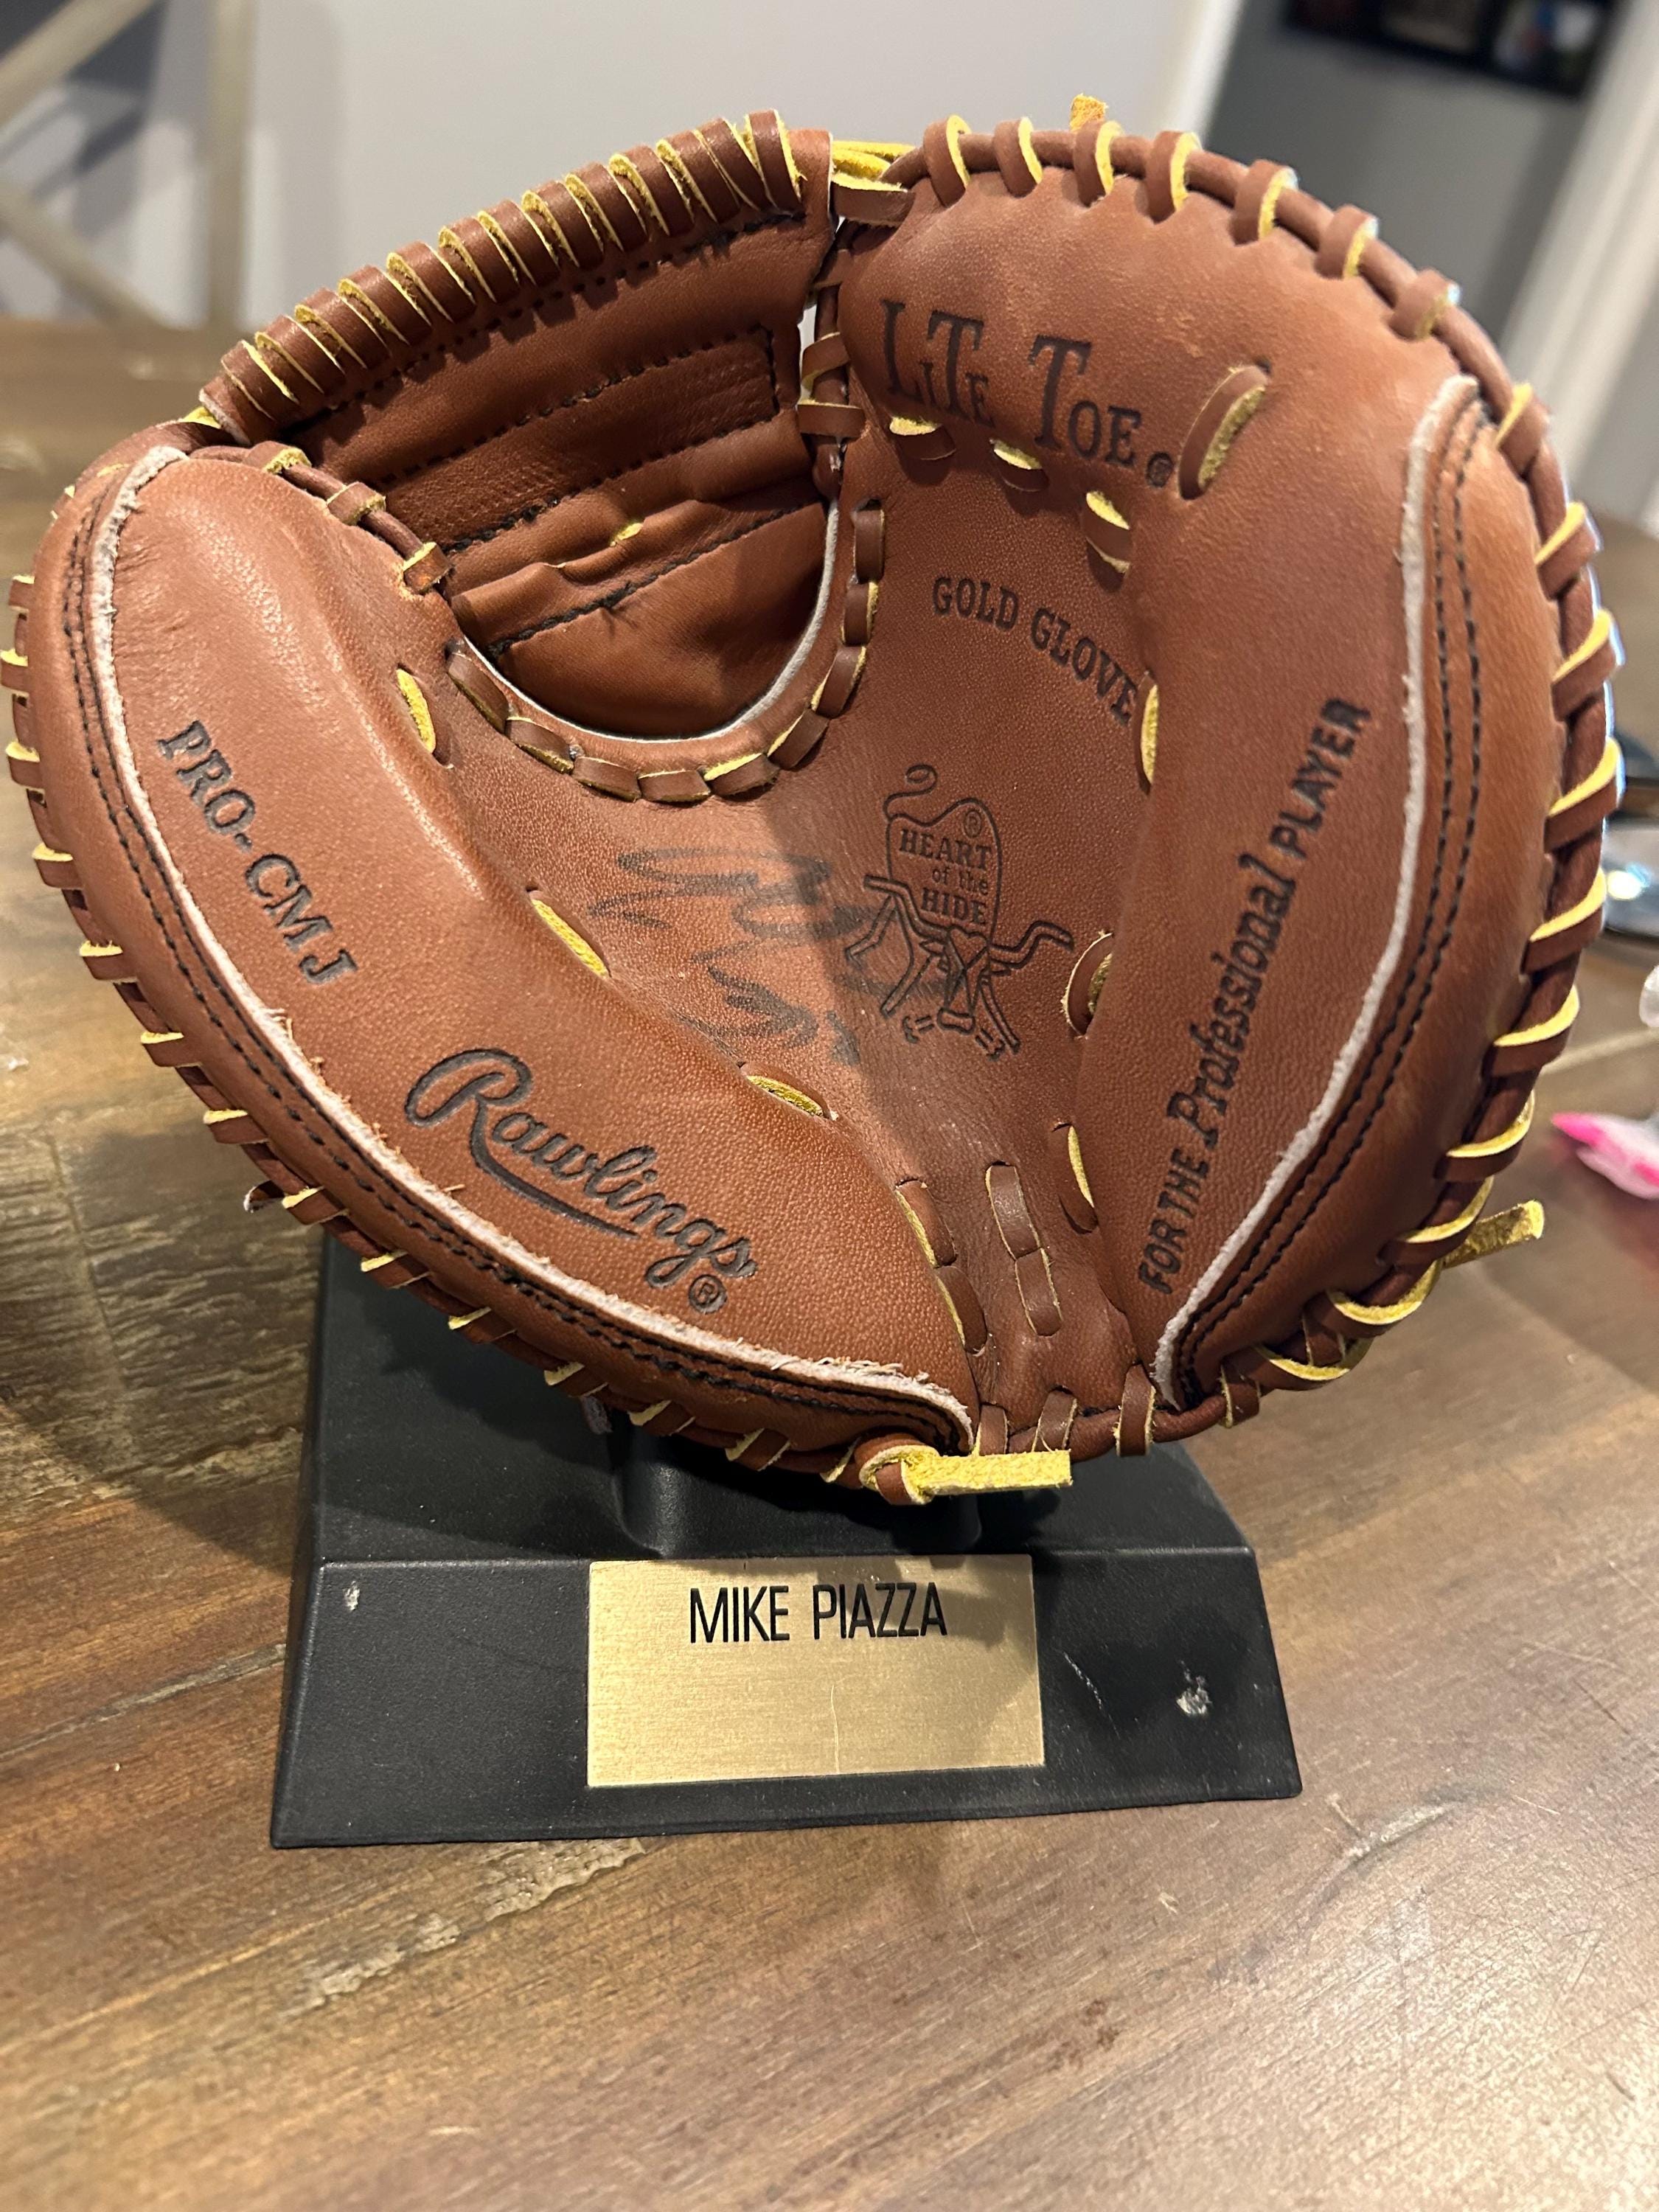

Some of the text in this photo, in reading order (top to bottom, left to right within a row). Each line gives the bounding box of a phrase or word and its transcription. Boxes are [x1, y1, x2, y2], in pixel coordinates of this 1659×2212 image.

[1029, 333, 1142, 469] TOE
[931, 575, 1138, 723] GOLD GLOVE
[899, 829, 992, 870] HEART
[931, 866, 989, 896] of the
[922, 888, 988, 925] HIDE
[1138, 697, 1372, 1295] FOR THE Professional PLAYER
[404, 1047, 759, 1289] Rawlings
[689, 1581, 948, 1644] MIKE PIAZZA
